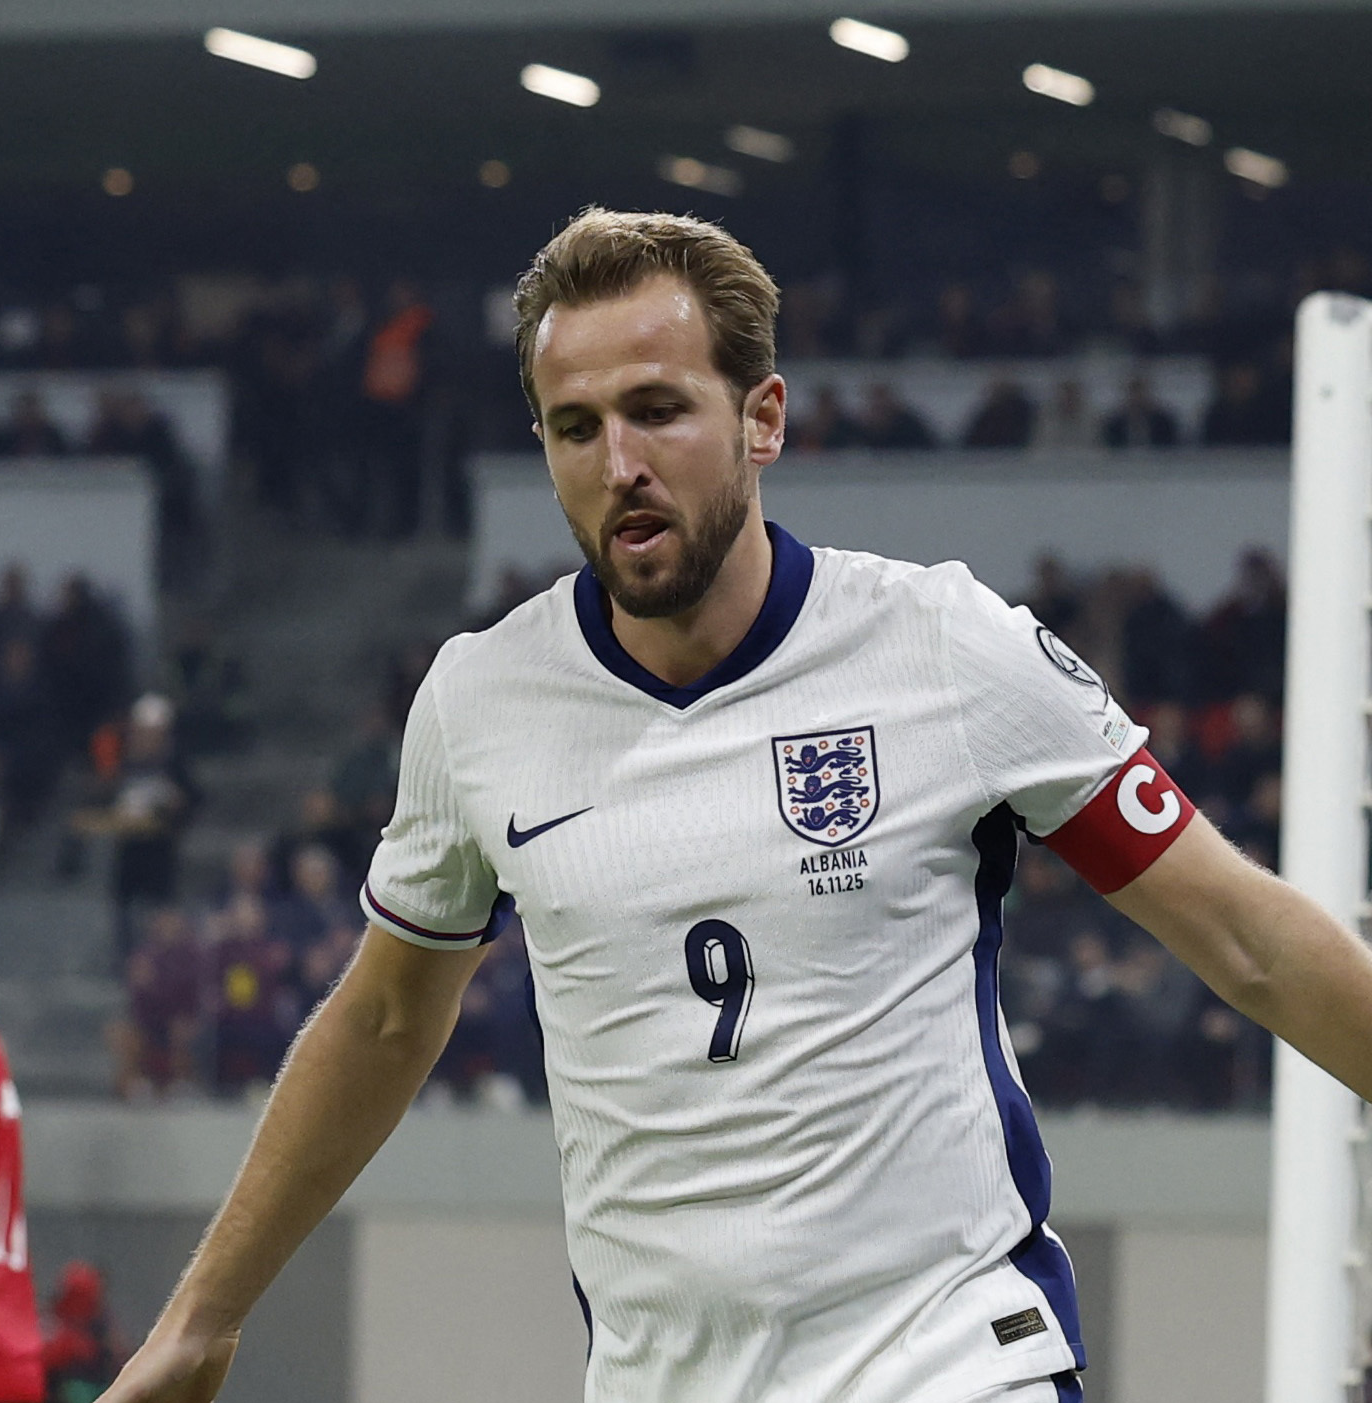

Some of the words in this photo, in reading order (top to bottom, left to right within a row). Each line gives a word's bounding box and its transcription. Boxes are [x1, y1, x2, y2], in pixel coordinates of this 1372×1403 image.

[1117, 764, 1181, 834] C
[800, 850, 868, 875] ALBANIA
[808, 873, 864, 896] 16.11.25
[685, 919, 755, 1063] 9
